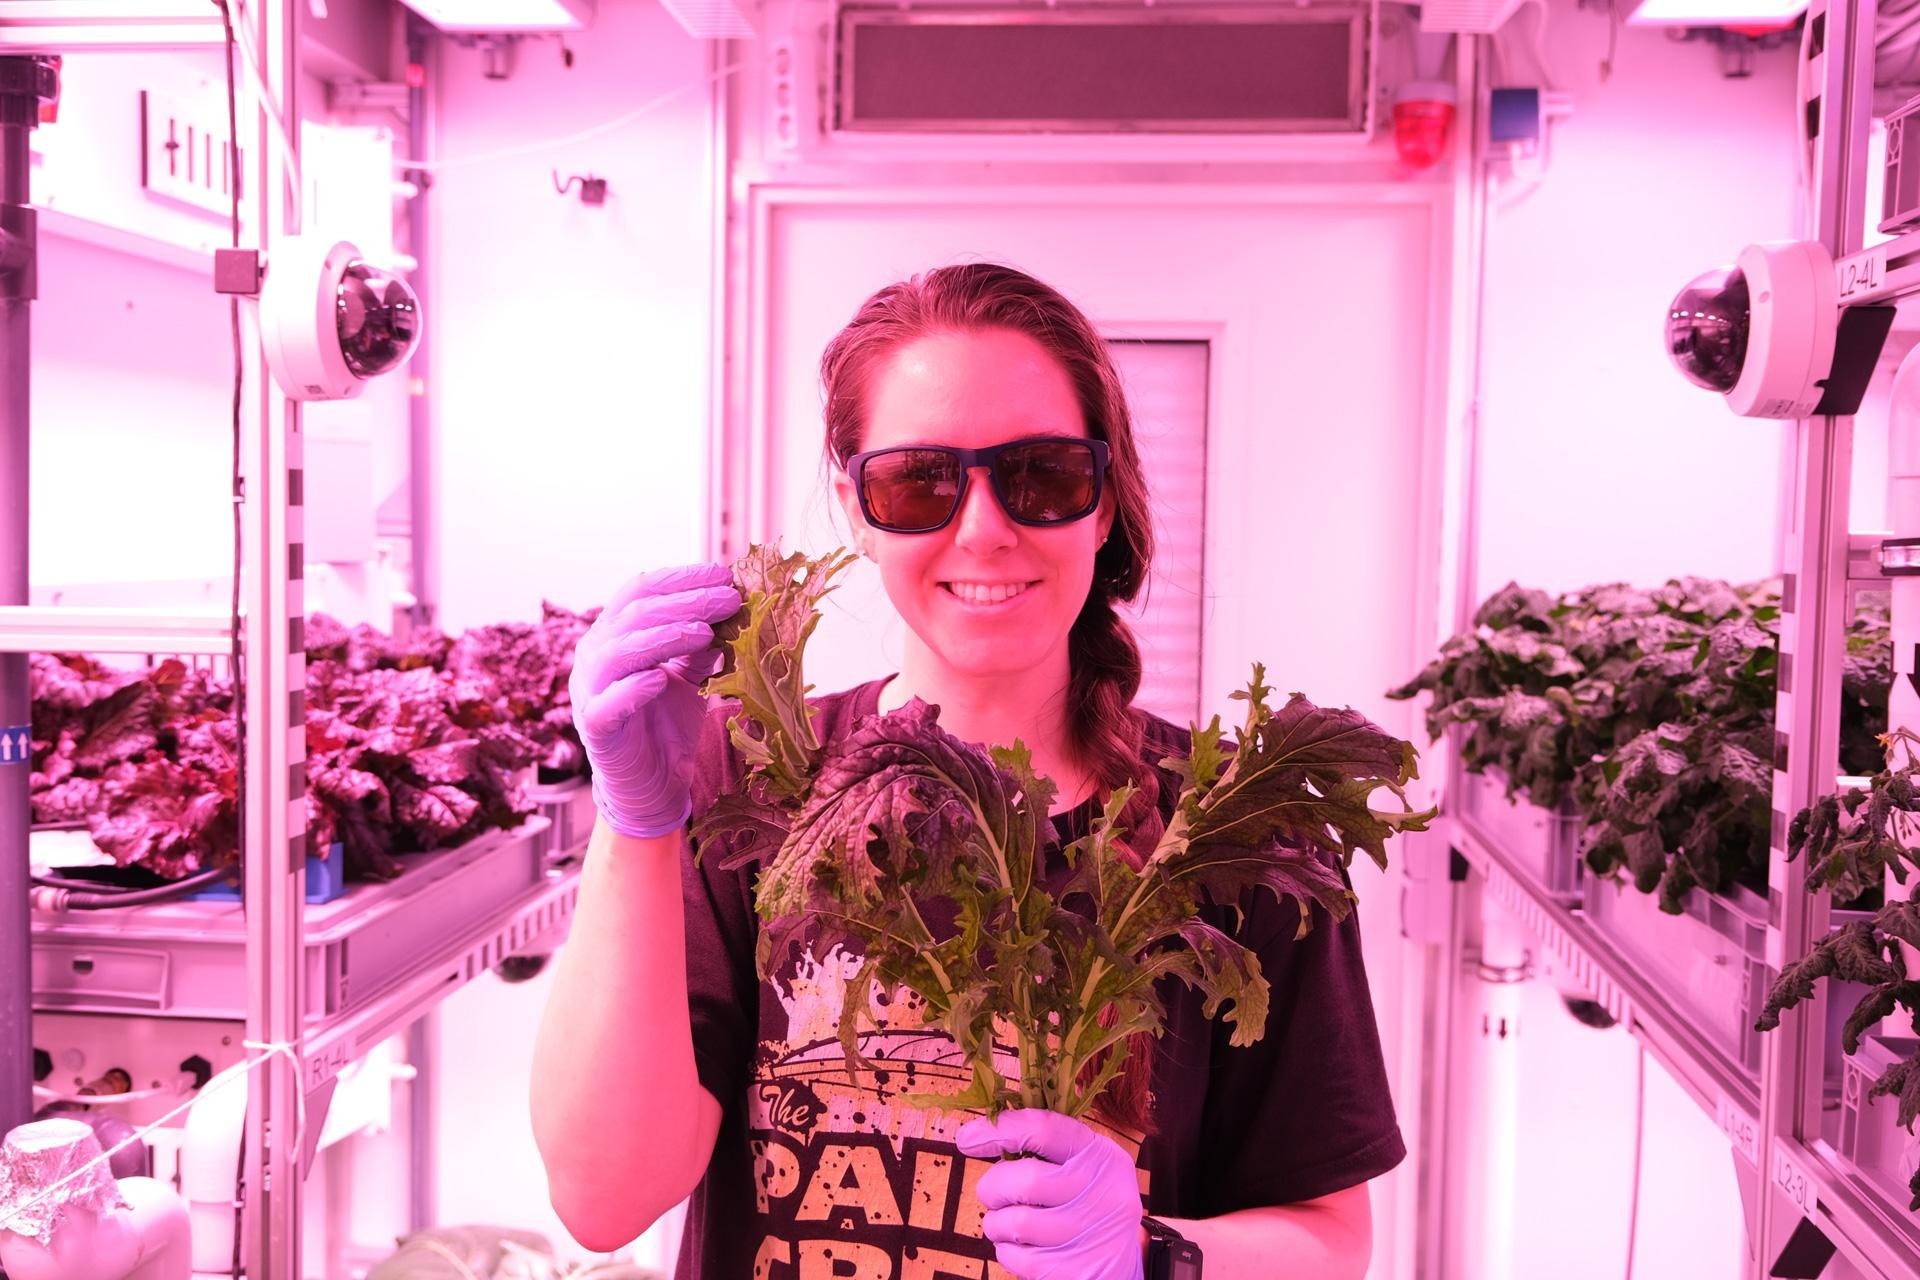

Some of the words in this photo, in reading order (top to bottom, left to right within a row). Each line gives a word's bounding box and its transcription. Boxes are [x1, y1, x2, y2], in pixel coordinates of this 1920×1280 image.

[1840, 256, 1877, 297] L2-4L
[761, 1085, 809, 1124] The
[751, 1139, 1150, 1239] PAI
[1778, 1155, 1810, 1214] L2-3L
